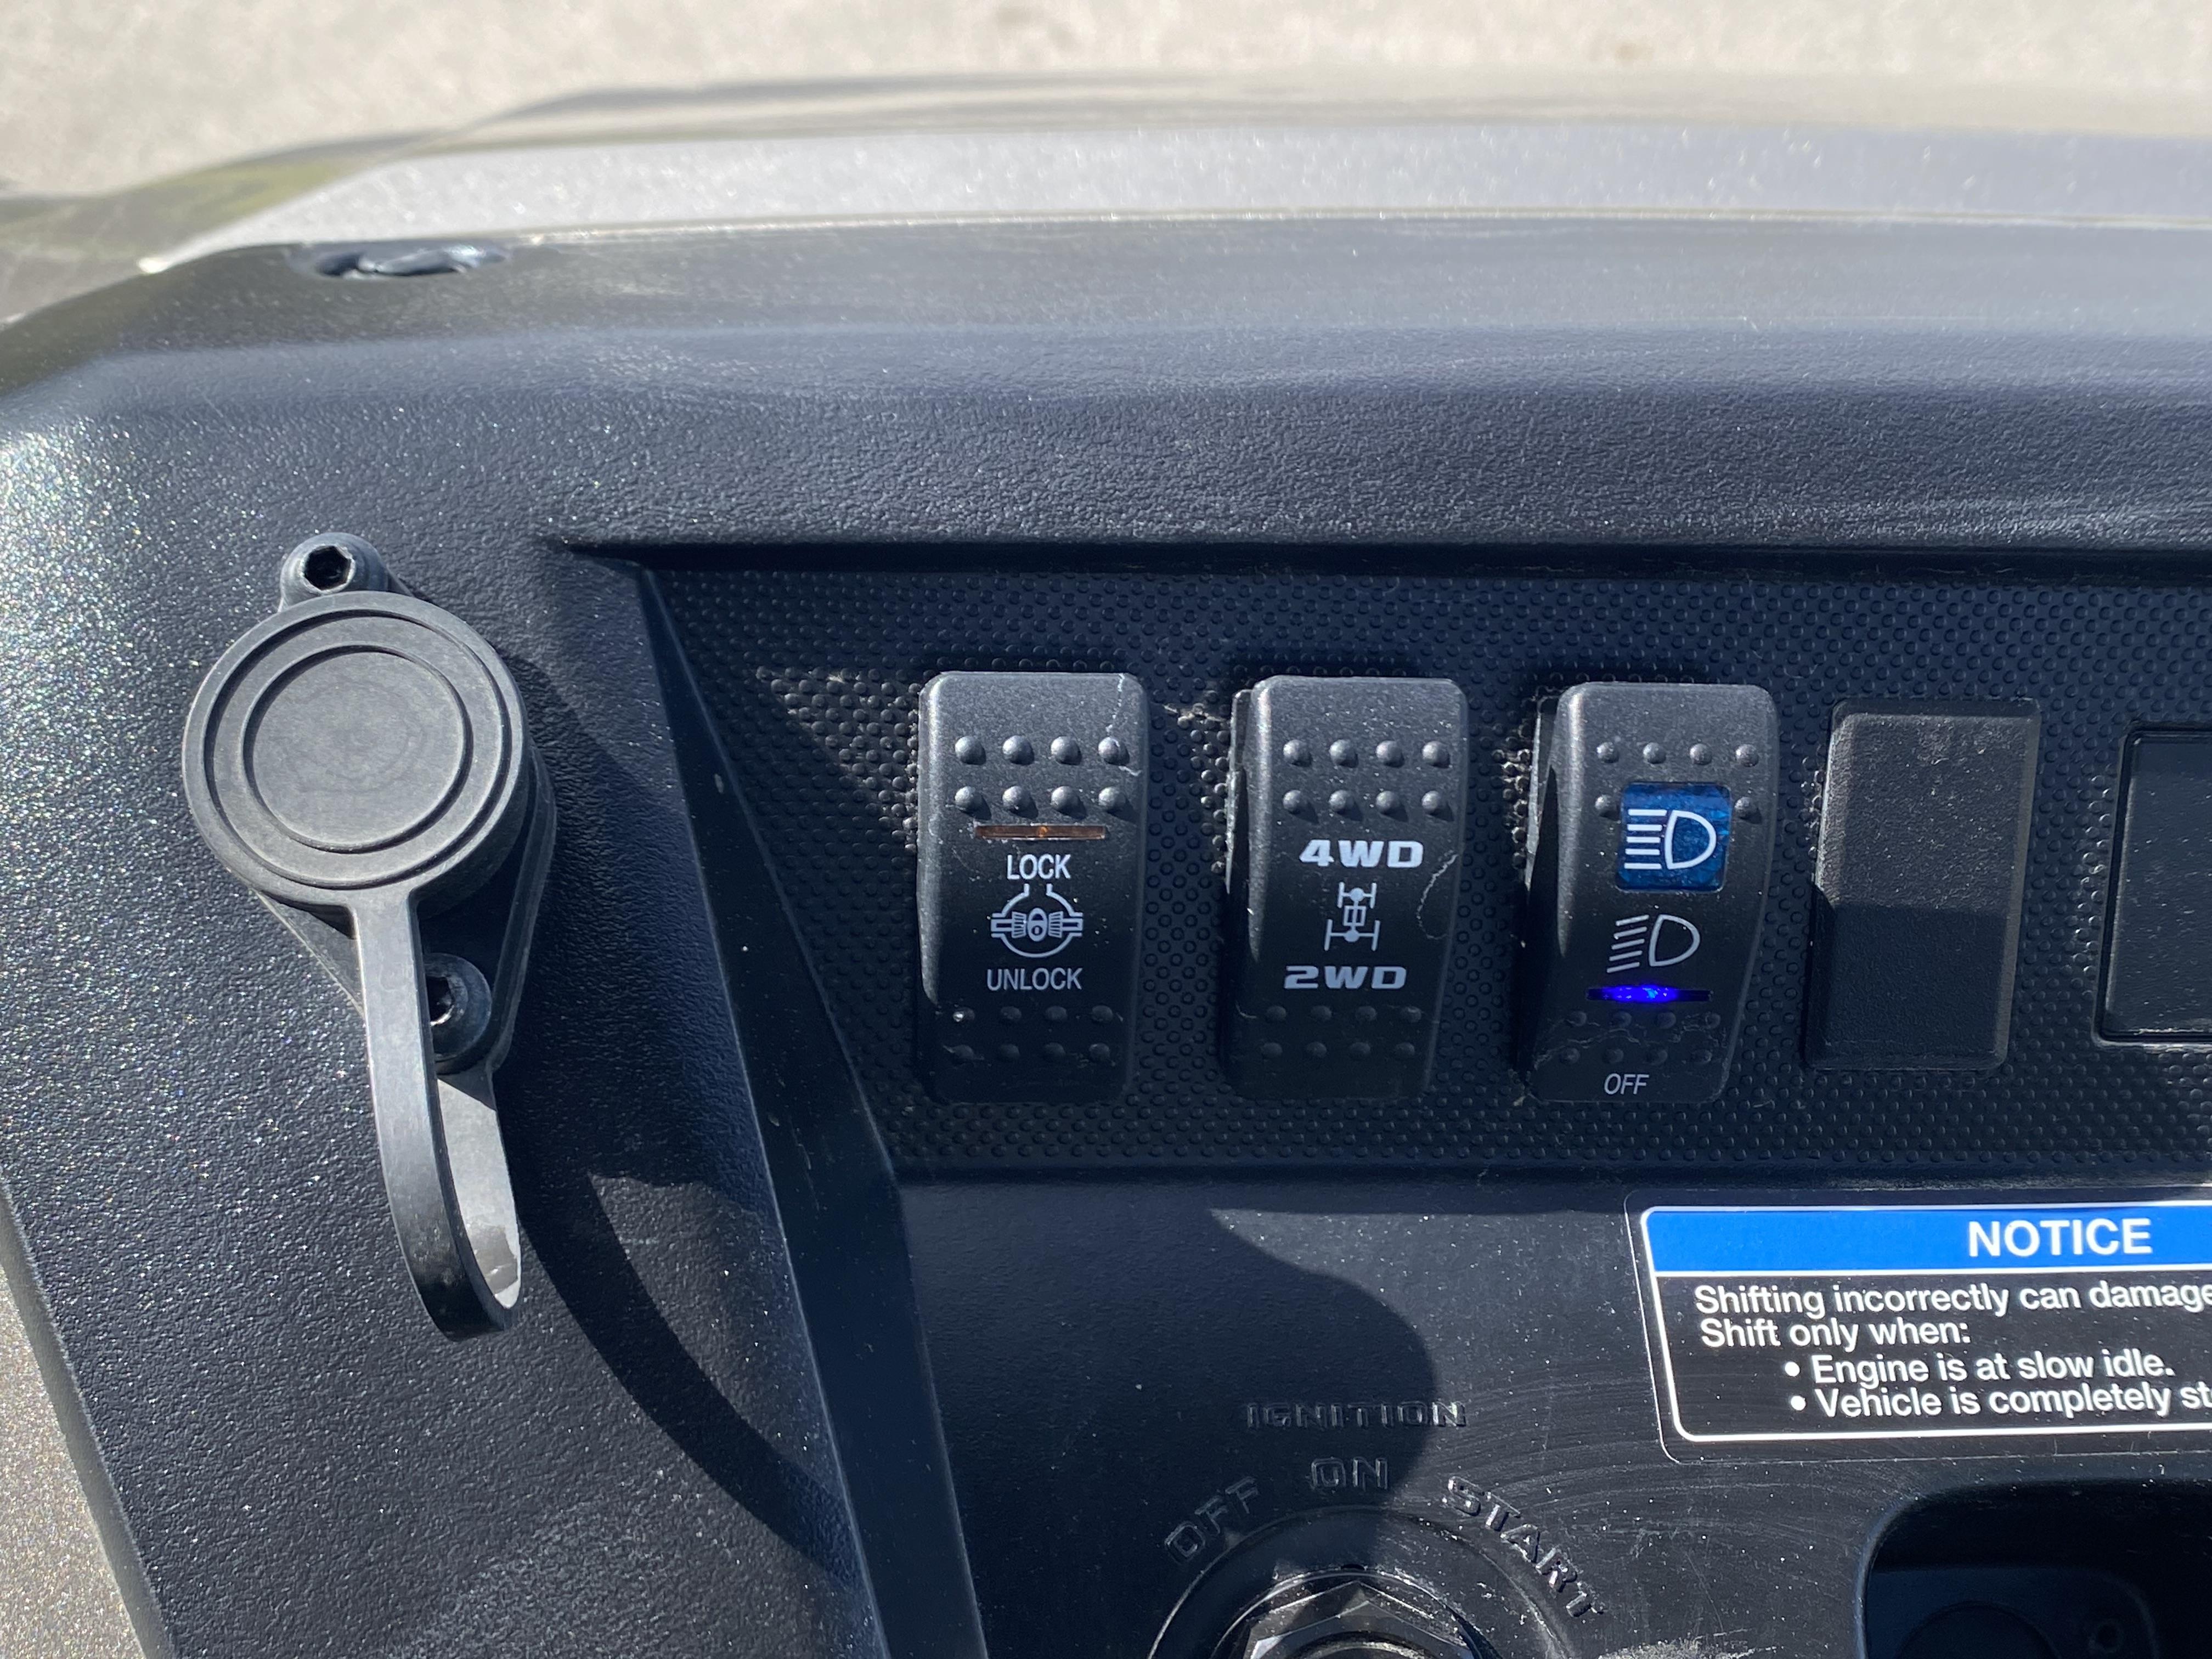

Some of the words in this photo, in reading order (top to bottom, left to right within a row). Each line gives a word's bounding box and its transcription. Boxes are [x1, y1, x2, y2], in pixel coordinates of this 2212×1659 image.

[1006, 853, 1071, 879] LOCK
[1298, 839, 1424, 869] 4WD
[987, 967, 1083, 991] UNLOCK
[1284, 965, 1407, 990] 2WD
[1604, 1074, 1649, 1095] OFF
[1967, 1218, 2153, 1258] NOTICE
[1695, 1285, 1827, 1318] Shifting
[1833, 1282, 2009, 1317] incorrectly
[2019, 1285, 2080, 1309] can
[1701, 1318, 1781, 1348] Shift
[1789, 1317, 1859, 1352] only
[1867, 1316, 1971, 1344] when:
[1812, 1354, 1929, 1389] Engine
[1938, 1353, 1967, 1381] is
[1975, 1353, 2009, 1381] at
[2017, 1351, 2095, 1379] slow
[2103, 1348, 2174, 1377] idle.
[1246, 1402, 1467, 1427] IGNITION
[1816, 1388, 1942, 1418] Vehicle
[1950, 1386, 1980, 1415] is
[1988, 1381, 2171, 1419] completely
[2180, 1382, 2212, 1409] st
[1310, 1457, 1389, 1490] ON
[1164, 1476, 1260, 1565] OFF
[1446, 1476, 1604, 1618] START
